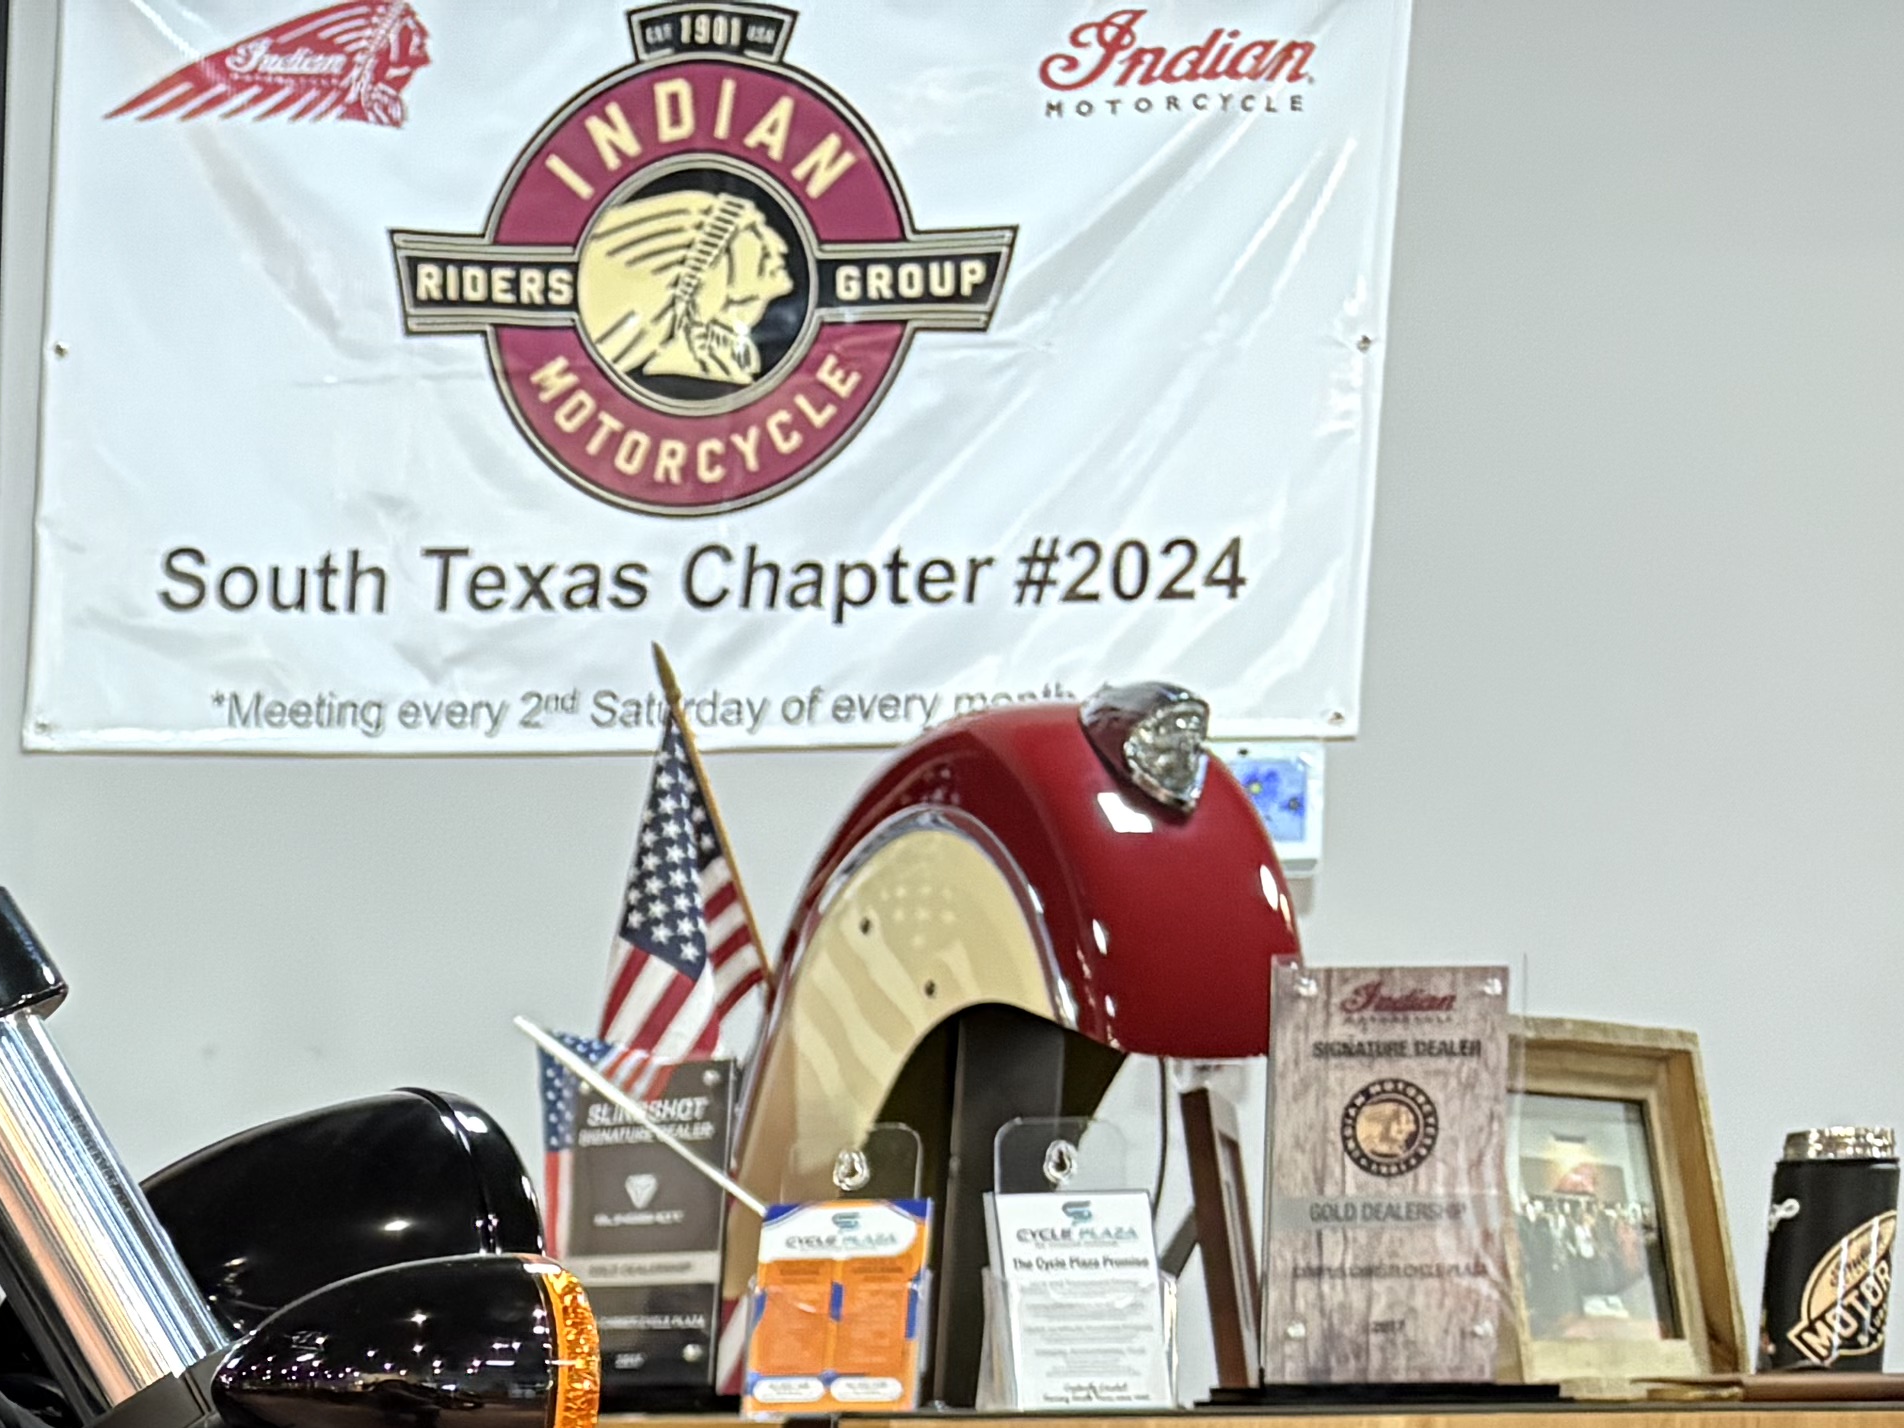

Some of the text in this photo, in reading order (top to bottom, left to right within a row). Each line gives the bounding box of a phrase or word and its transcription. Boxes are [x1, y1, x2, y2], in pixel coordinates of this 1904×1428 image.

[680, 15, 741, 46] 1901
[1039, 9, 1316, 91] Indian
[1045, 94, 1304, 118] MOTORCYCLE
[545, 77, 859, 200] INDIAN
[416, 263, 574, 305] RIDERS
[836, 259, 988, 301] GROUP
[529, 354, 861, 485] MOTORCYCLE
[158, 537, 1249, 626] South Texas Chapter #2024
[398, 697, 510, 737] every
[781, 686, 824, 722] of
[831, 691, 940, 730] every
[1342, 979, 1457, 1012] Indian
[1312, 1038, 1483, 1059] SIGNATURE DEALER
[1309, 1202, 1358, 1223] GOLD
[1016, 1227, 1072, 1243] CYCLE
